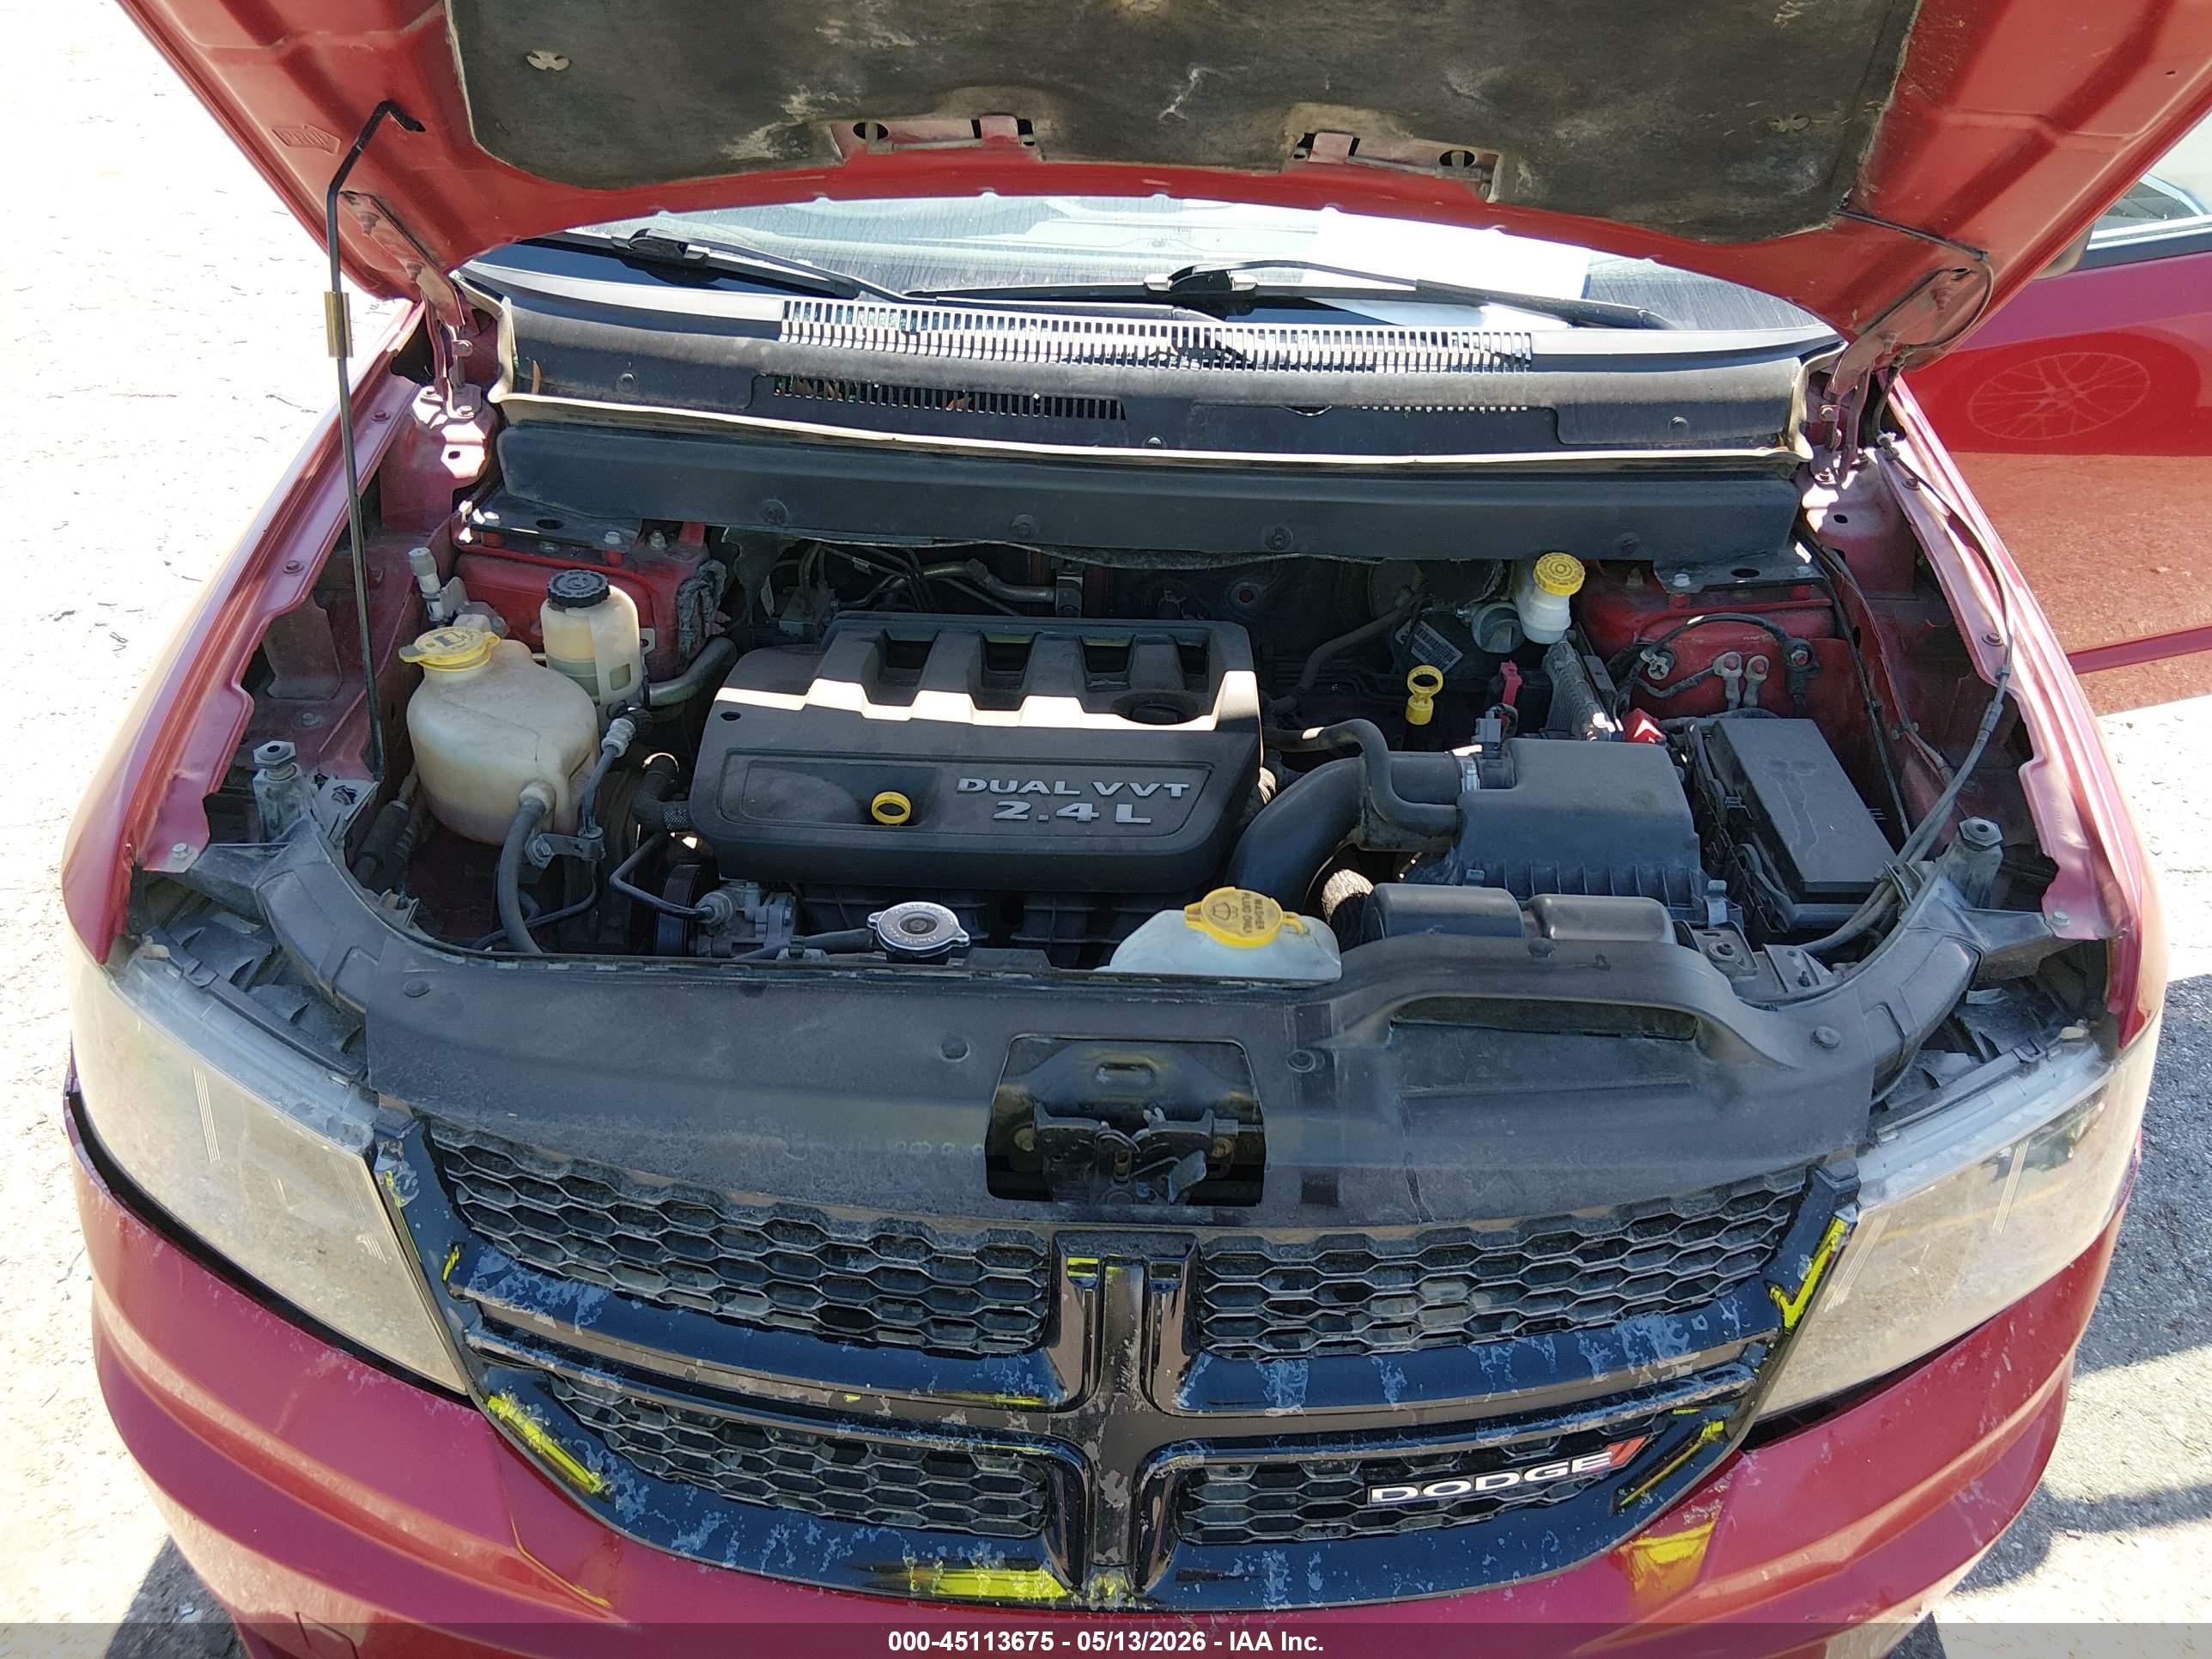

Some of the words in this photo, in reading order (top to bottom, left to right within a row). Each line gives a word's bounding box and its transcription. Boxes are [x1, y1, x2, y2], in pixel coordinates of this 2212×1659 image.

[957, 778, 1081, 795] DUAL
[1092, 781, 1190, 798] VVT
[992, 800, 1100, 823] 2.4
[1115, 803, 1152, 824] L
[1242, 892, 1252, 914] FLUID
[1255, 898, 1266, 930] WASHER
[1243, 915, 1253, 933] ONLY
[1371, 1451, 1613, 1503] DODGE
